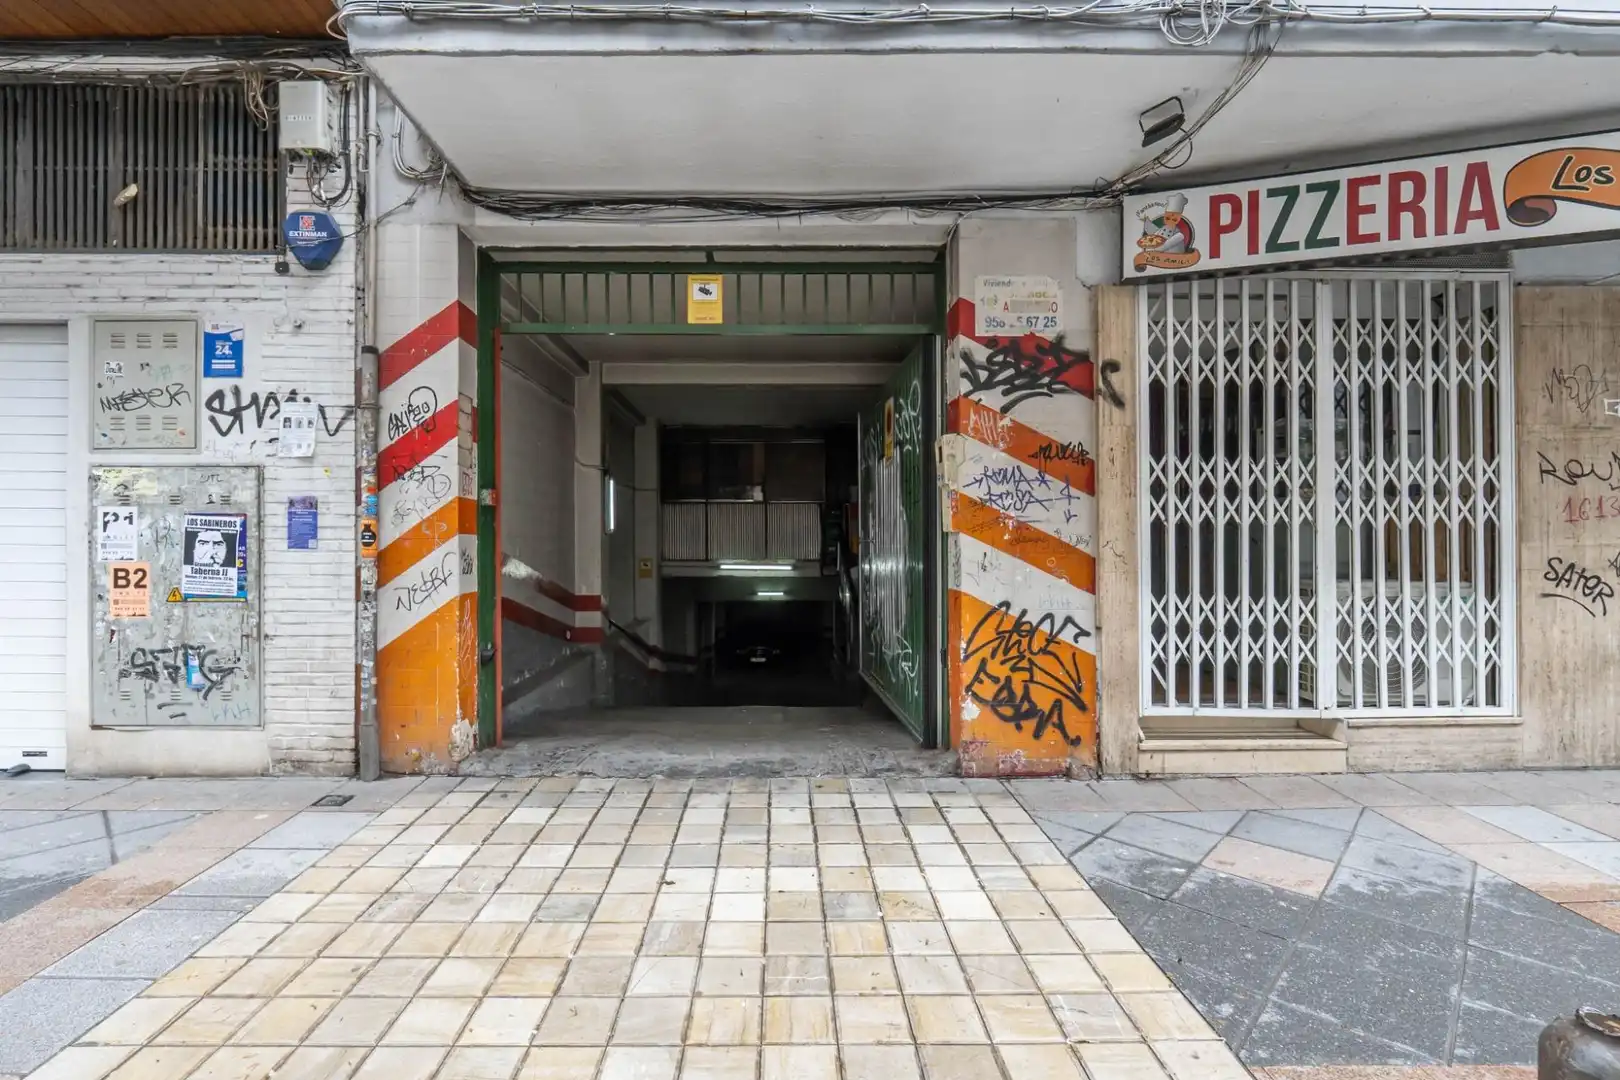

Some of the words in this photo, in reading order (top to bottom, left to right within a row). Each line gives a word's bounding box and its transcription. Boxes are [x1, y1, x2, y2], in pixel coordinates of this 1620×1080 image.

[1550, 154, 1616, 192] Los
[1208, 160, 1500, 260] PIZZERIA
[983, 279, 1012, 289] Viviend
[1026, 316, 1040, 328] 67
[1043, 316, 1058, 328] 25
[187, 518, 199, 527] LOS
[199, 519, 238, 529] SABINEROS
[190, 566, 220, 576] Taberna
[113, 567, 148, 589] B2
